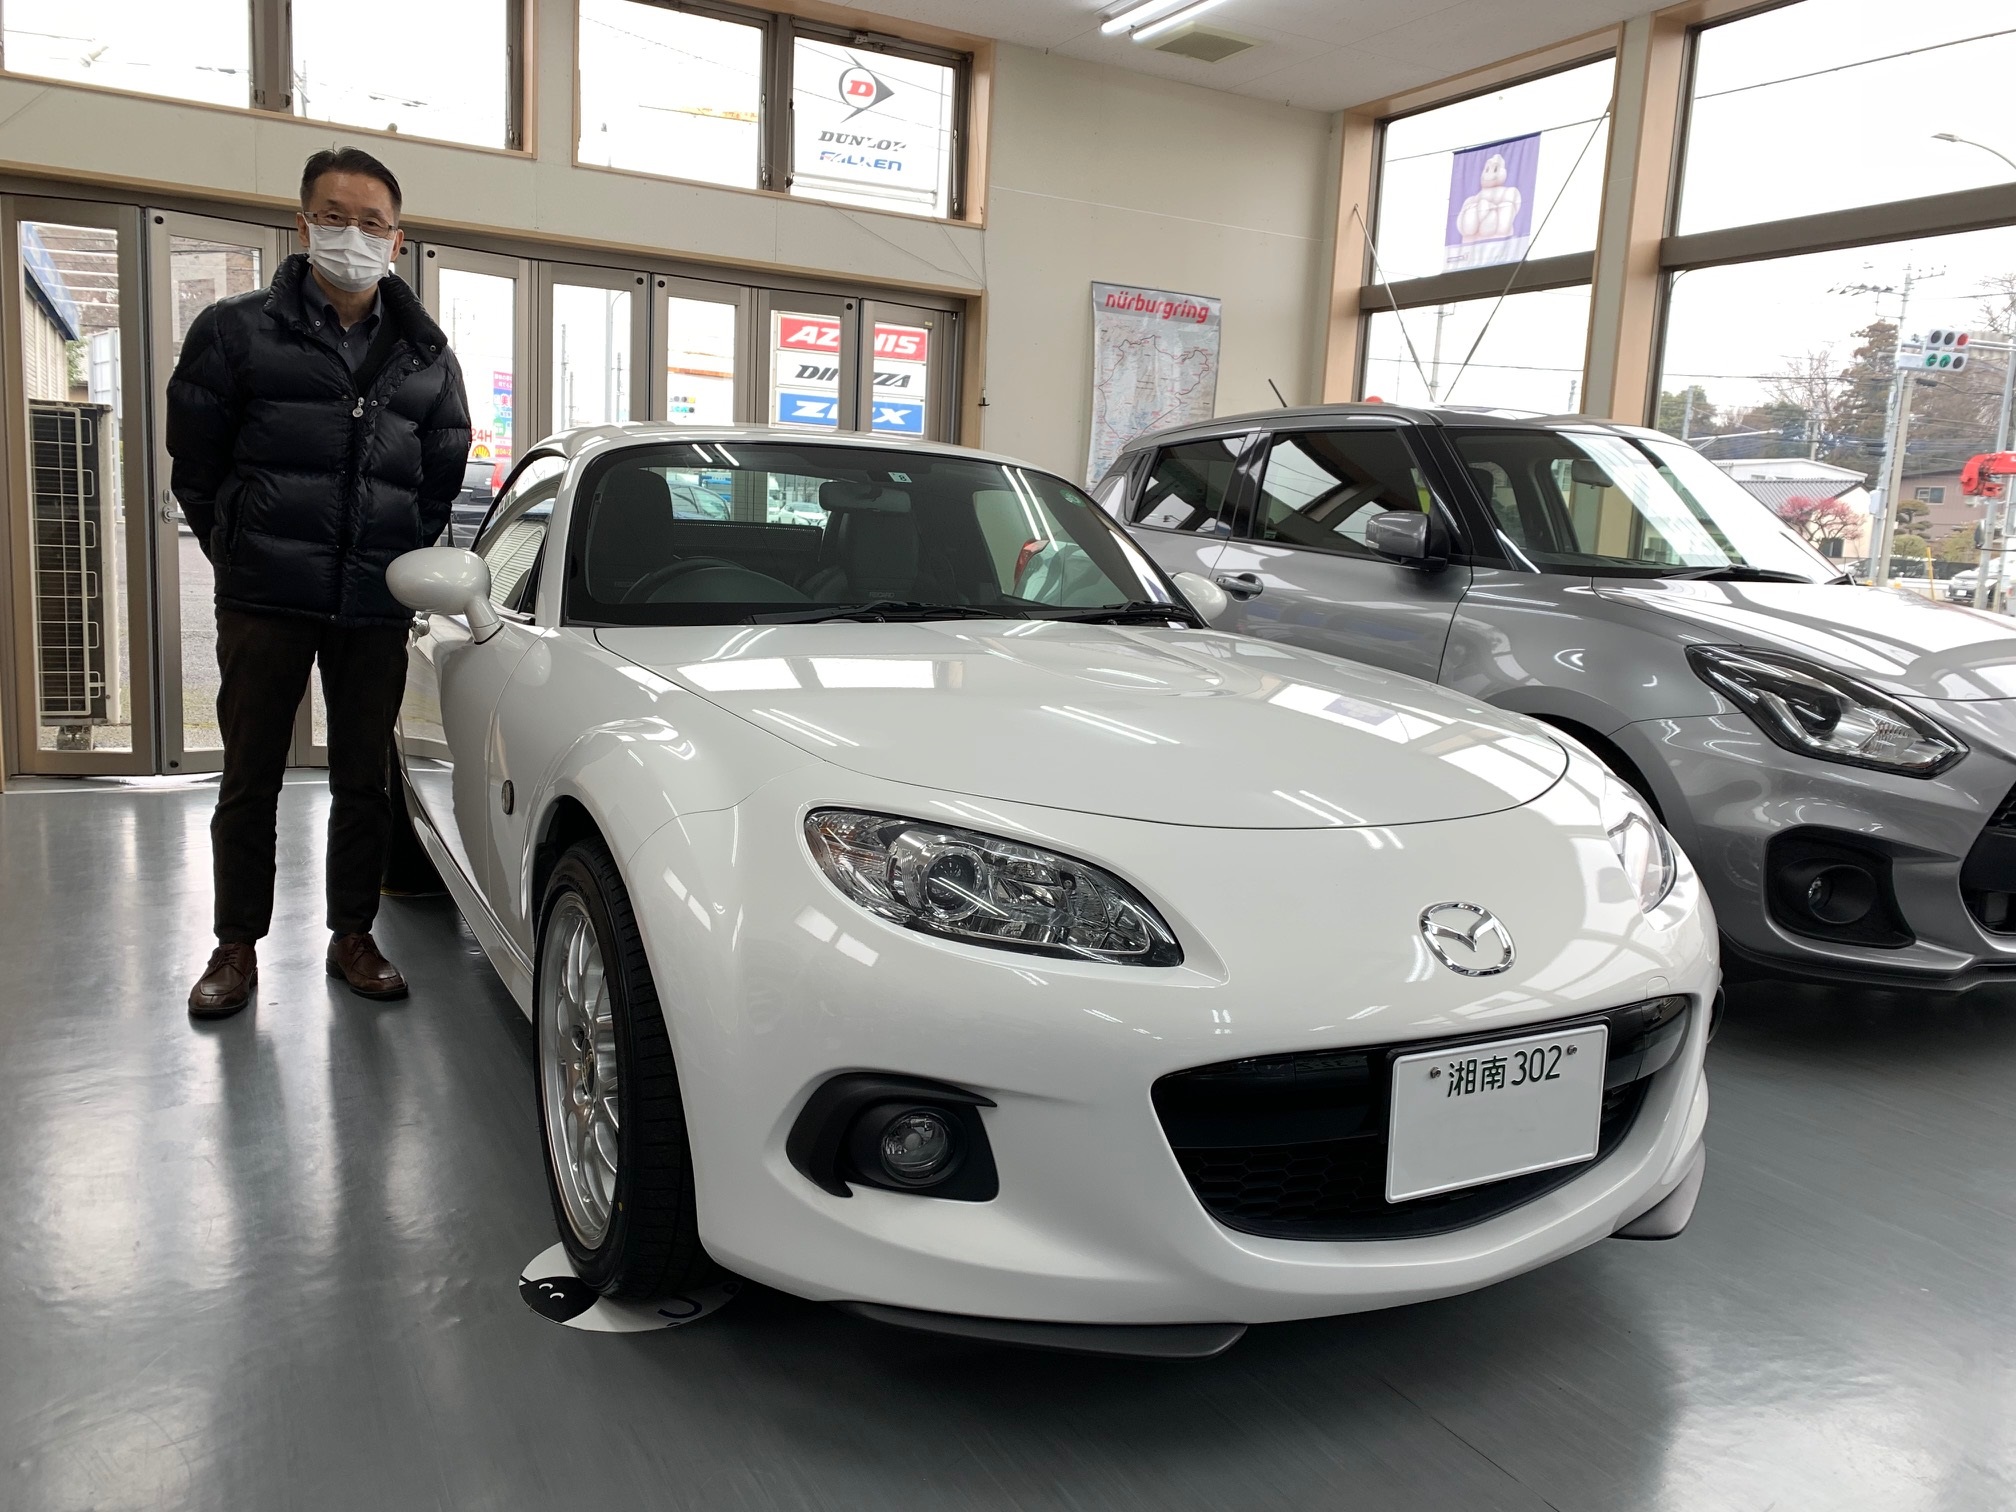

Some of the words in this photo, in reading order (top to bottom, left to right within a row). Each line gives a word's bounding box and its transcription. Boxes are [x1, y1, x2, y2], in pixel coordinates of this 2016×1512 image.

[847, 80, 874, 97] D
[1105, 291, 1210, 323] nürburgring
[786, 325, 921, 355] AZNIS
[795, 364, 911, 388] DIZZA
[791, 400, 912, 425] ZIX
